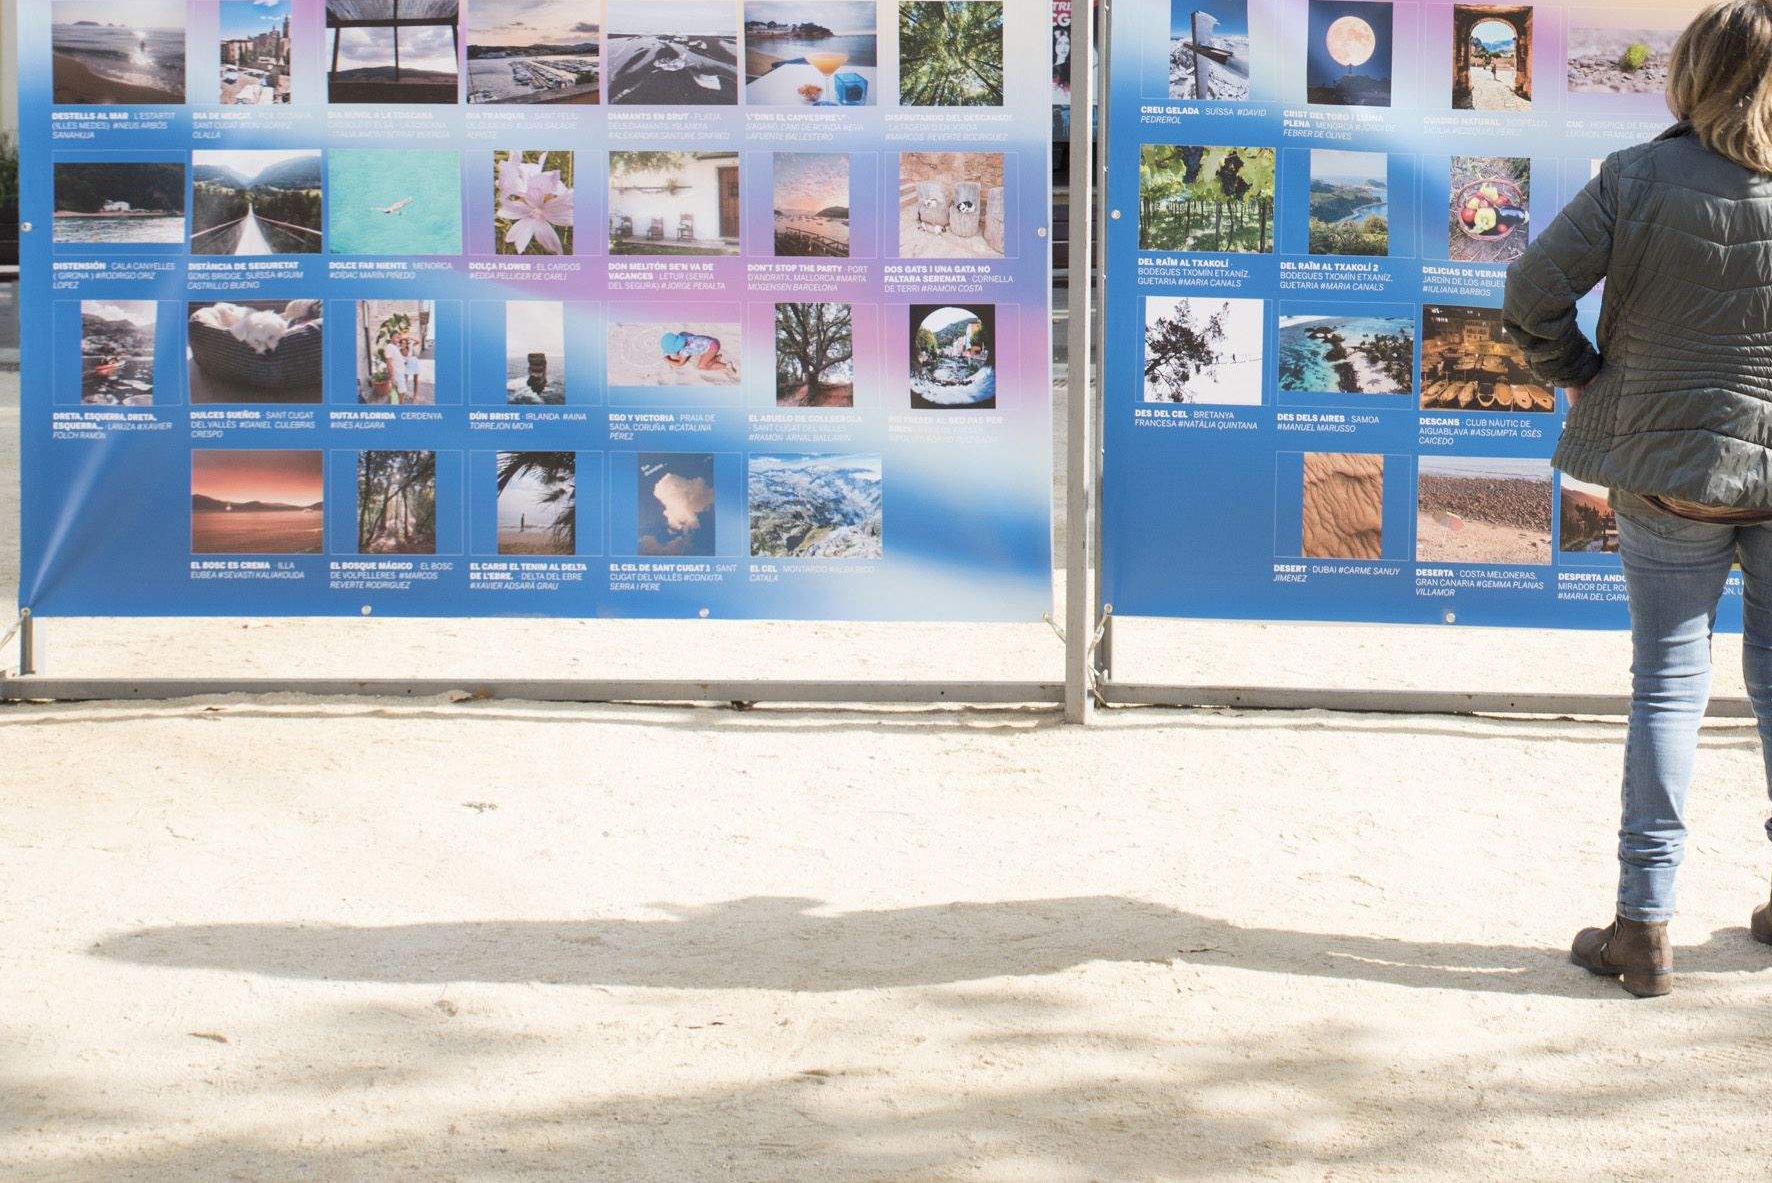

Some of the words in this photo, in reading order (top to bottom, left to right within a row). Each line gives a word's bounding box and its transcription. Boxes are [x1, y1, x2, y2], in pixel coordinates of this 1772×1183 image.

[1140, 106, 1164, 115] CREU
[1166, 106, 1200, 116] GELADA
[1237, 108, 1266, 117] #DAVID
[1140, 114, 1182, 125] PEDREROL
[608, 262, 627, 271] DON
[629, 261, 667, 271] MELITÓN
[690, 263, 700, 272] VA
[703, 263, 714, 272] DE
[884, 265, 903, 274] DOS
[905, 265, 927, 274] GATS
[929, 265, 932, 274] I
[934, 265, 952, 274] UNA
[954, 265, 976, 274] GATA
[978, 265, 991, 274] NO
[1280, 262, 1296, 271] DEL
[1322, 262, 1332, 271] AL
[1373, 263, 1378, 272] 2
[608, 413, 626, 422] EGO
[628, 413, 633, 422] Y
[635, 413, 674, 422] VICTORIA
[680, 414, 703, 422] PRAIA
[705, 414, 716, 422] DE
[1134, 409, 1152, 418] DES
[1154, 410, 1170, 419] DEL
[1172, 410, 1188, 419] CEL
[1194, 411, 1234, 420] BRETANYA
[1277, 413, 1294, 422] DES
[1296, 413, 1318, 422] DELS
[1320, 414, 1345, 423] AIRES
[1351, 415, 1380, 424] SAMOA
[1419, 417, 1460, 427] DESCANS
[1466, 418, 1487, 428] CLUB
[1520, 420, 1531, 429] DE
[610, 564, 620, 572] EL
[622, 564, 637, 572] CEL
[639, 564, 650, 572] DE
[652, 564, 674, 572] SANT
[677, 564, 704, 572] CUGAT
[706, 564, 711, 572] 1
[716, 564, 737, 573] SANT
[1415, 568, 1454, 578] DESERTA
[1459, 569, 1485, 579] COSTA
